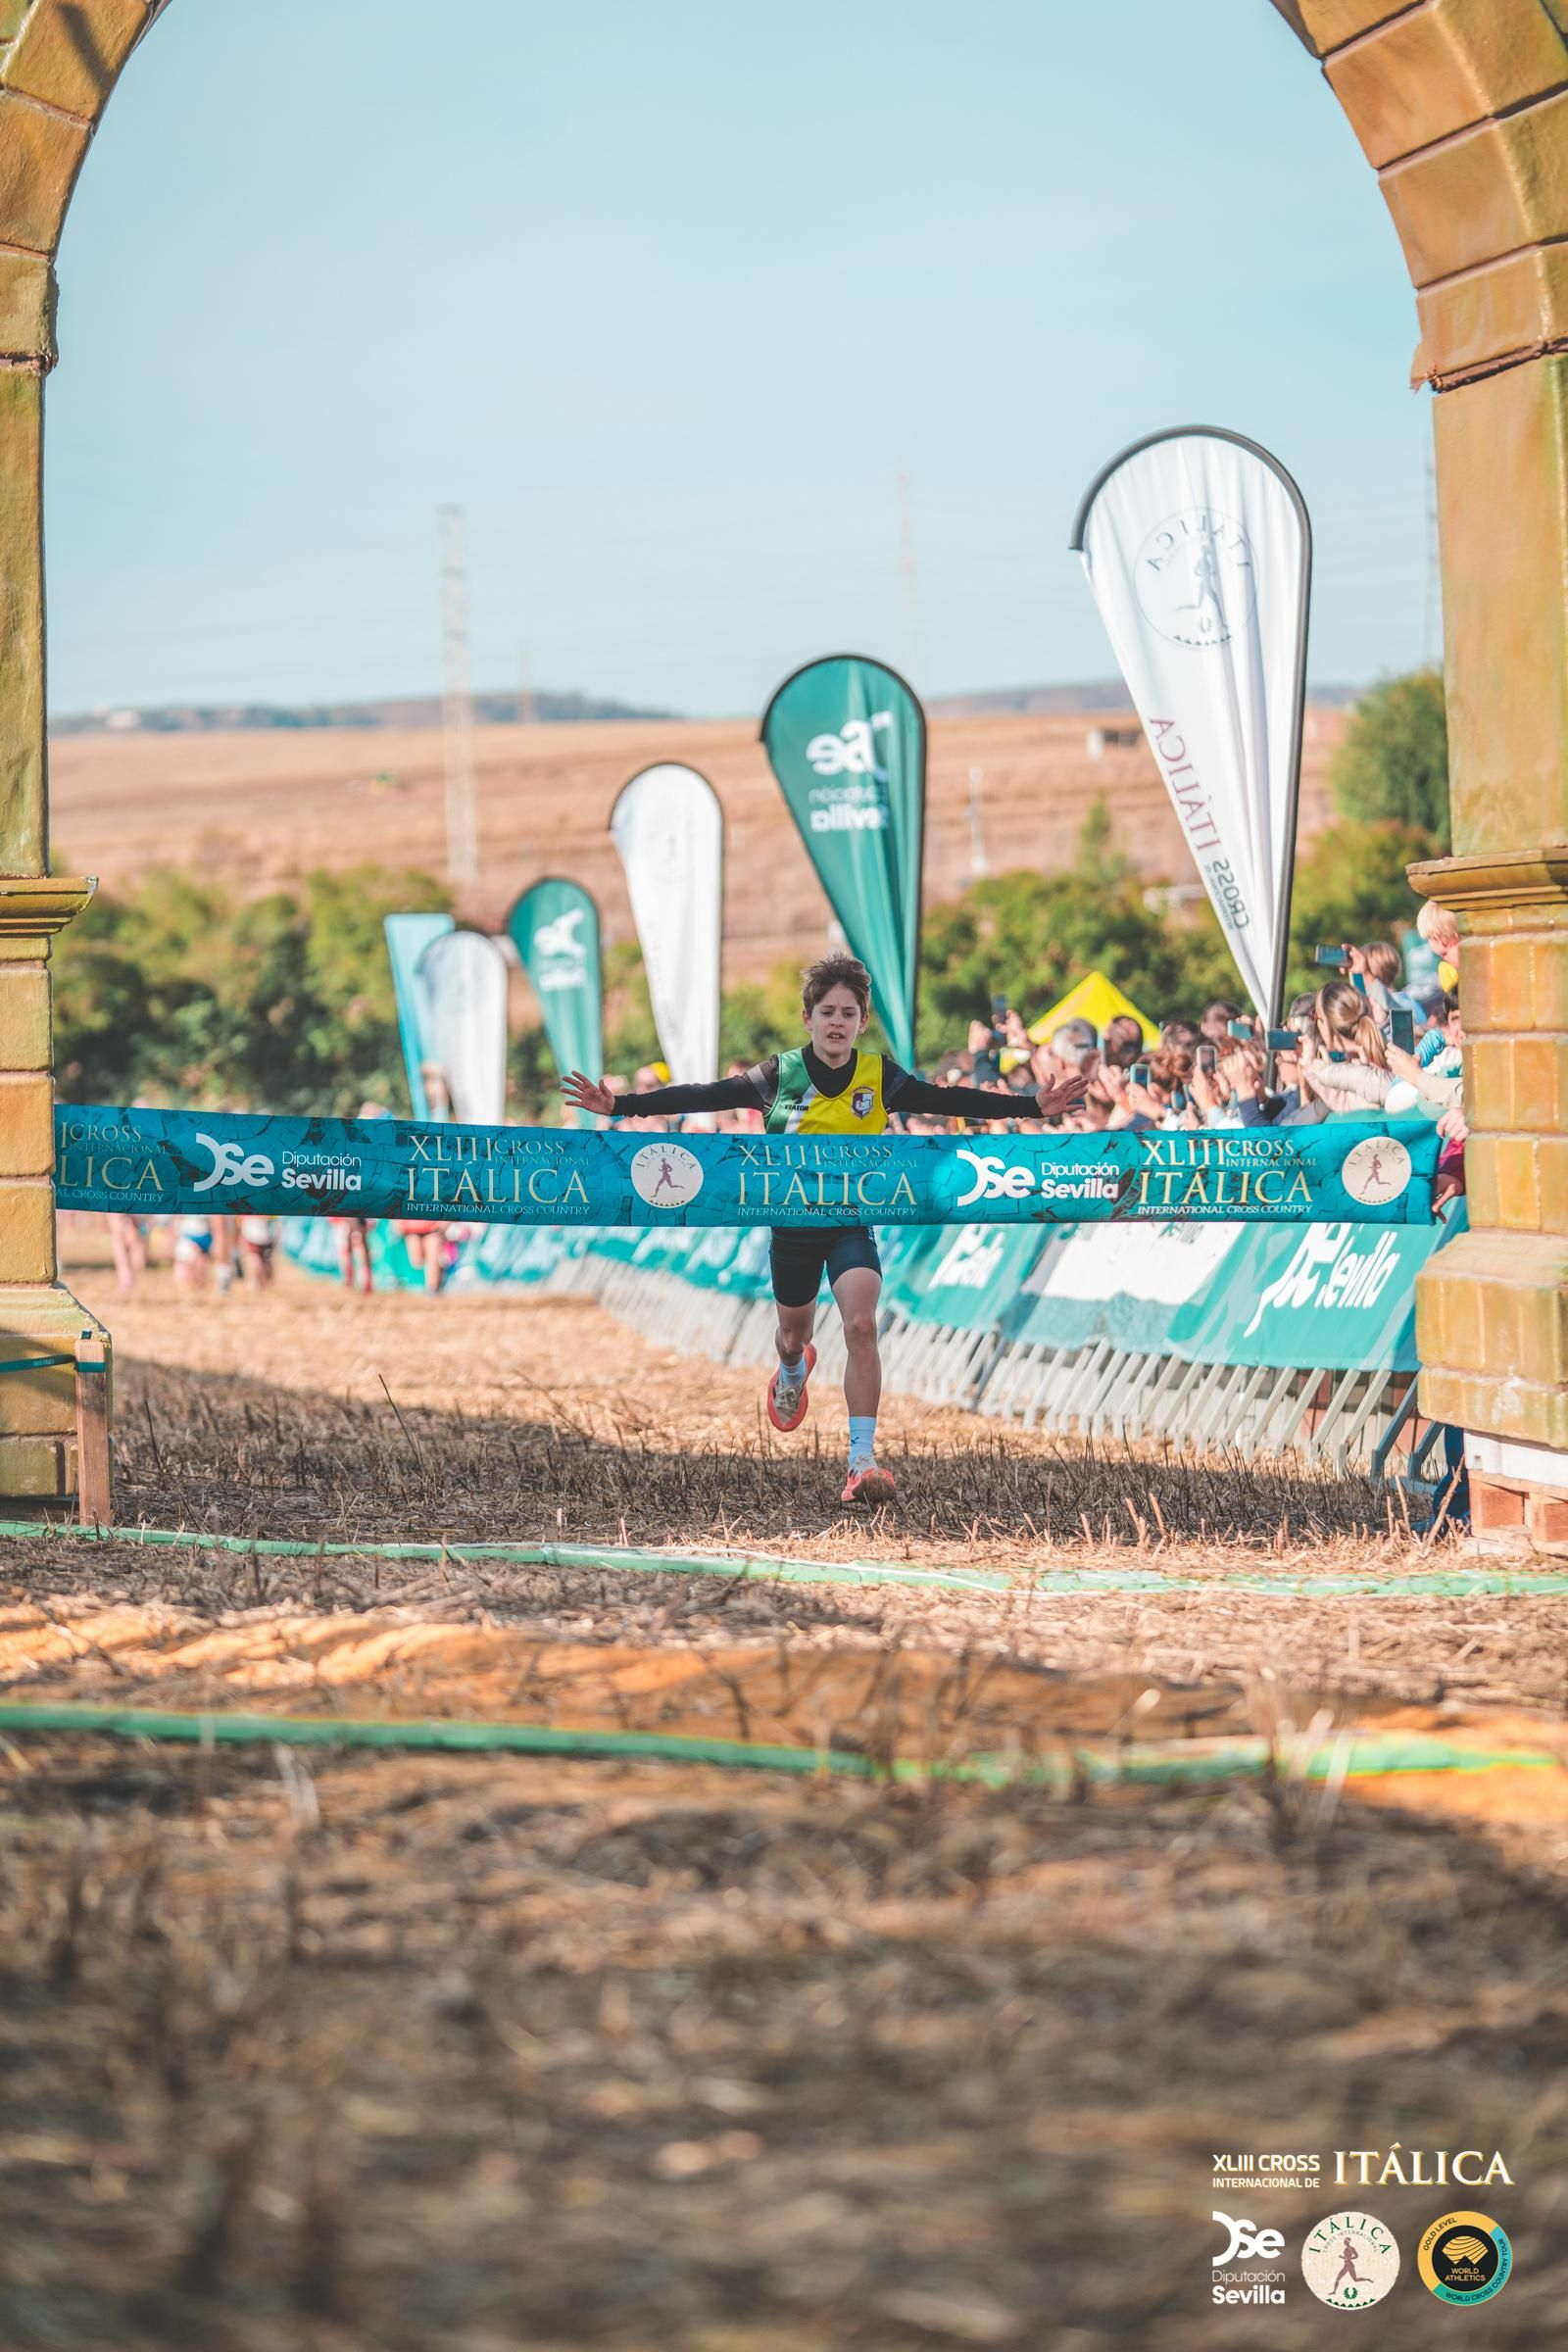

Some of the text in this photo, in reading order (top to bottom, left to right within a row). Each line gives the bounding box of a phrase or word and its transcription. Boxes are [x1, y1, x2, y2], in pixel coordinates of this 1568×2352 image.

[70, 1123, 141, 1143] CROSS
[409, 1135, 564, 1161] XLIII CROSS
[739, 1145, 893, 1166] XLIII CROSS
[1142, 1139, 1295, 1166] XLIII CROSS
[282, 1151, 361, 1167] Diputación
[1226, 1157, 1317, 1167] INTERNACIONAL
[60, 1155, 165, 1191] LICA
[281, 1168, 362, 1191] Sevilla
[1041, 1161, 1120, 1179] Diputación
[407, 1160, 590, 1203] ITÁLICA
[737, 1165, 917, 1205] ITÁLICA
[1041, 1178, 1120, 1200] Sevilla
[1138, 1164, 1313, 1204] ITÁLICA
[73, 1189, 107, 1200] CROSS
[110, 1191, 164, 1202] COUNTRY
[407, 1203, 590, 1215] INTERNATIONAL CROSS COUNTRY
[737, 1207, 917, 1216] INTERNATIONAL CROSS COUNTRY
[1138, 1204, 1313, 1214] INTERNATIONAL CROSS COUNTRY
